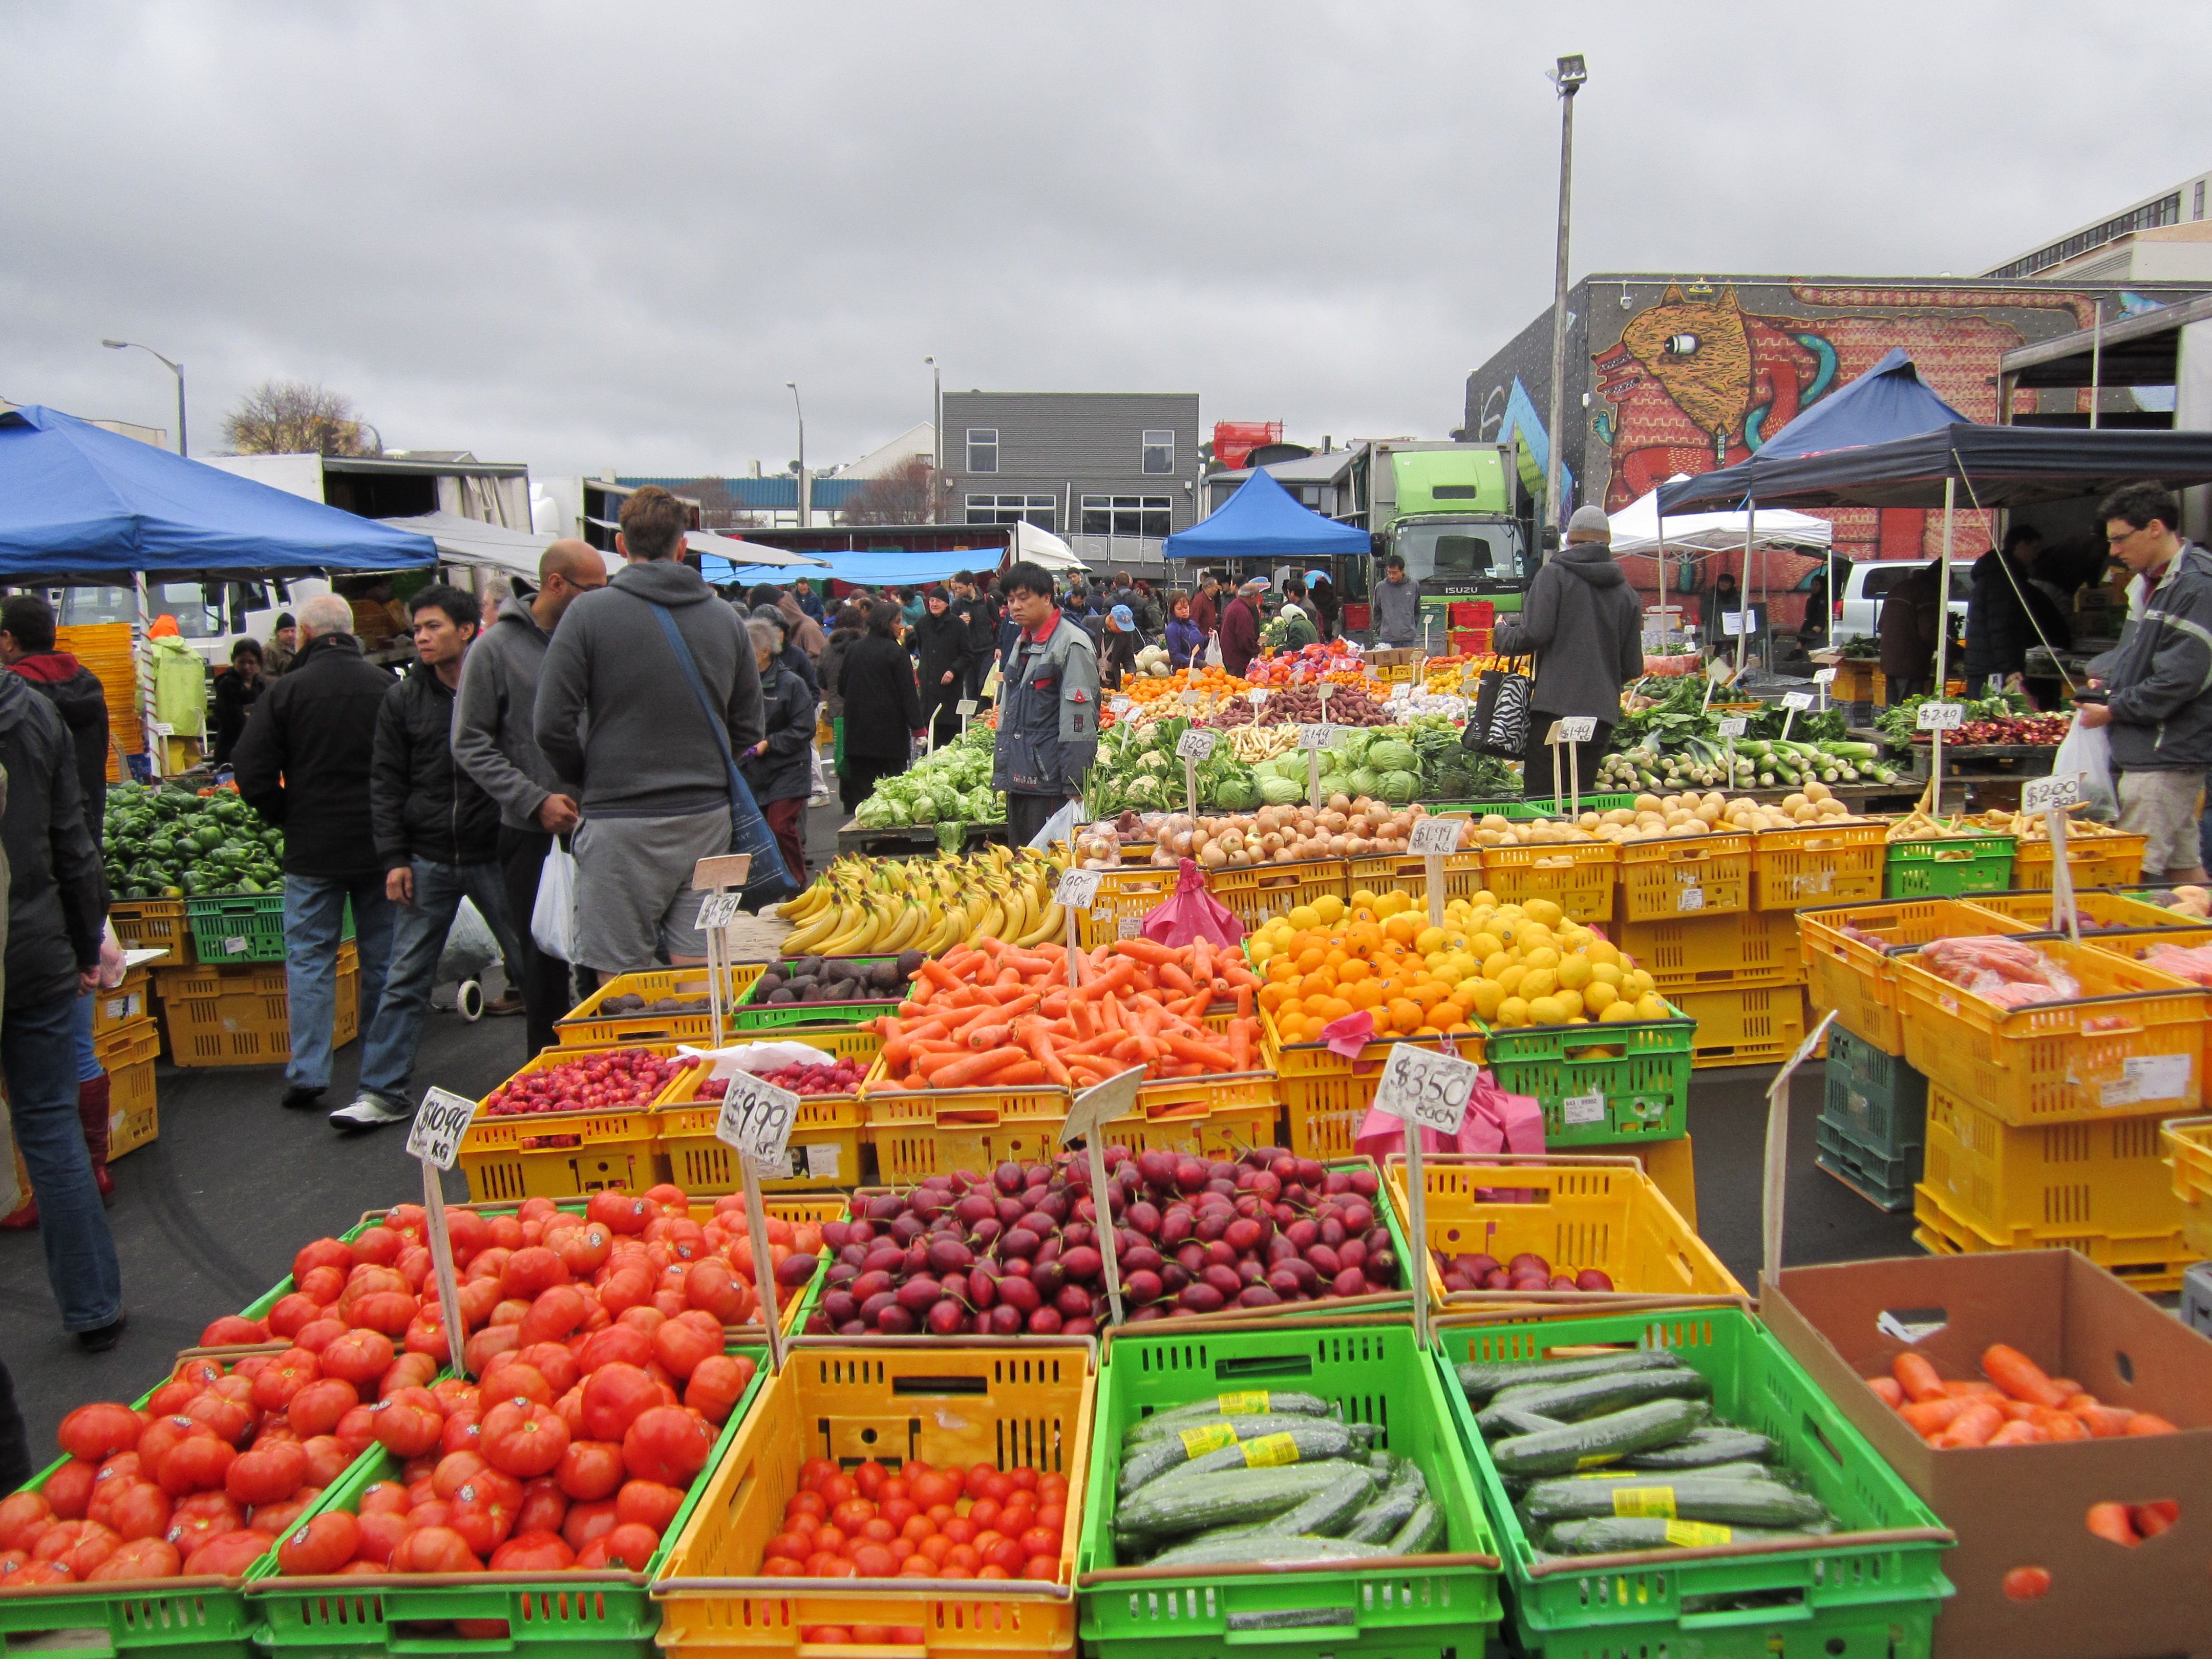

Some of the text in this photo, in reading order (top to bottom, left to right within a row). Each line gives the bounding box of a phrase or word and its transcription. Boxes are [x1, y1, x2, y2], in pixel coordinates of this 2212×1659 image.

[1920, 708, 1956, 722] $2.49
[1182, 734, 1211, 750] $2.00
[2027, 780, 2077, 807] $2.00
[1416, 826, 1452, 842] $1.99
[1434, 842, 1450, 853] KG
[418, 1099, 467, 1141] $10.99
[1415, 1102, 1455, 1125] each
[431, 1140, 450, 1162] KG
